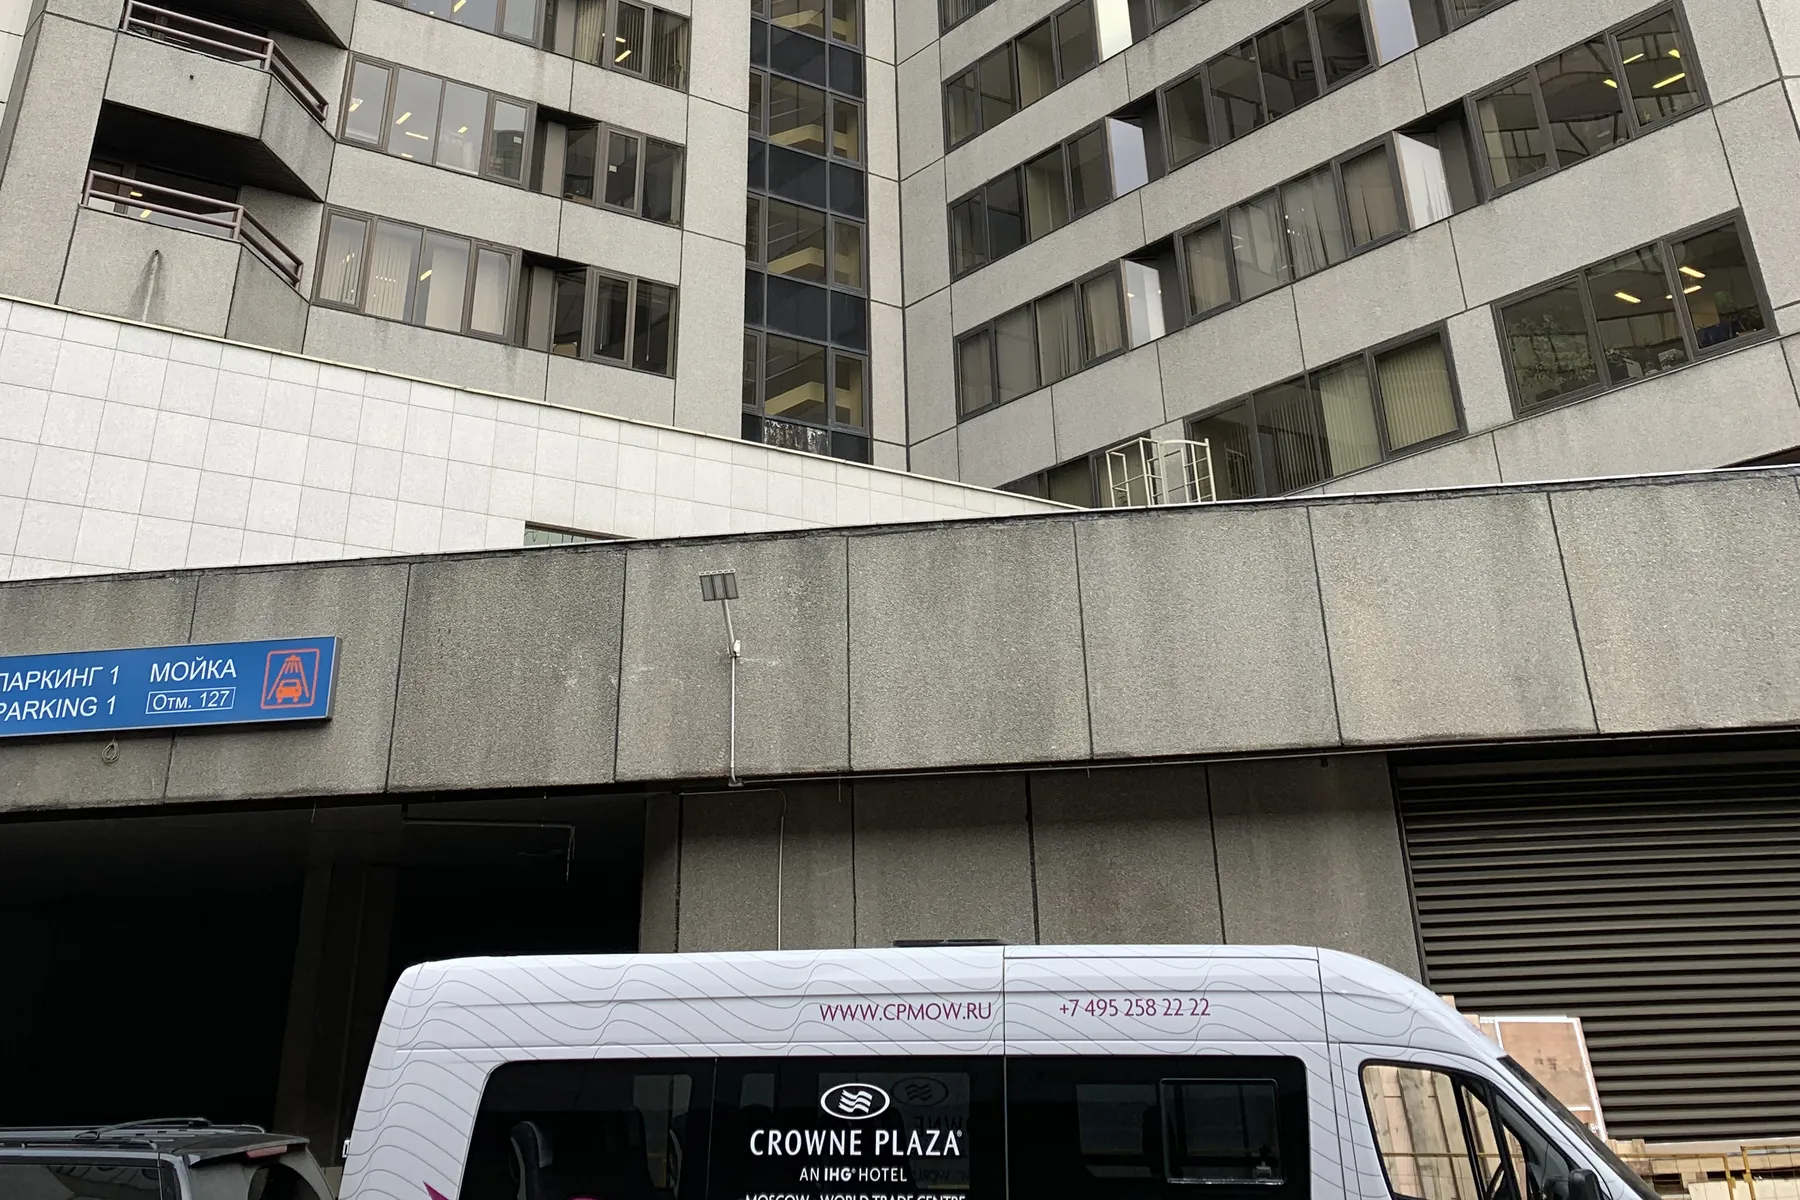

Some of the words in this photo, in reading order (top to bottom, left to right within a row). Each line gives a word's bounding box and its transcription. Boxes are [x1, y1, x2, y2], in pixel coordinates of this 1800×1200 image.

[0, 666, 103, 692] ПАРКИНГ
[110, 665, 119, 685] 1
[149, 656, 237, 683] МОЙКА
[106, 695, 116, 715] 1
[152, 694, 192, 711] Отм.
[199, 690, 230, 708] 127
[819, 1002, 992, 1021] WWW.CPMOW.RU
[1059, 999, 1080, 1017] +7
[1084, 999, 1119, 1017] 495
[1123, 999, 1157, 1017] 258
[1162, 998, 1184, 1017] 22
[1189, 998, 1211, 1017] 22
[750, 1130, 862, 1156] CROWNE
[799, 1167, 820, 1182] AN
[859, 1167, 908, 1182] HOTEL
